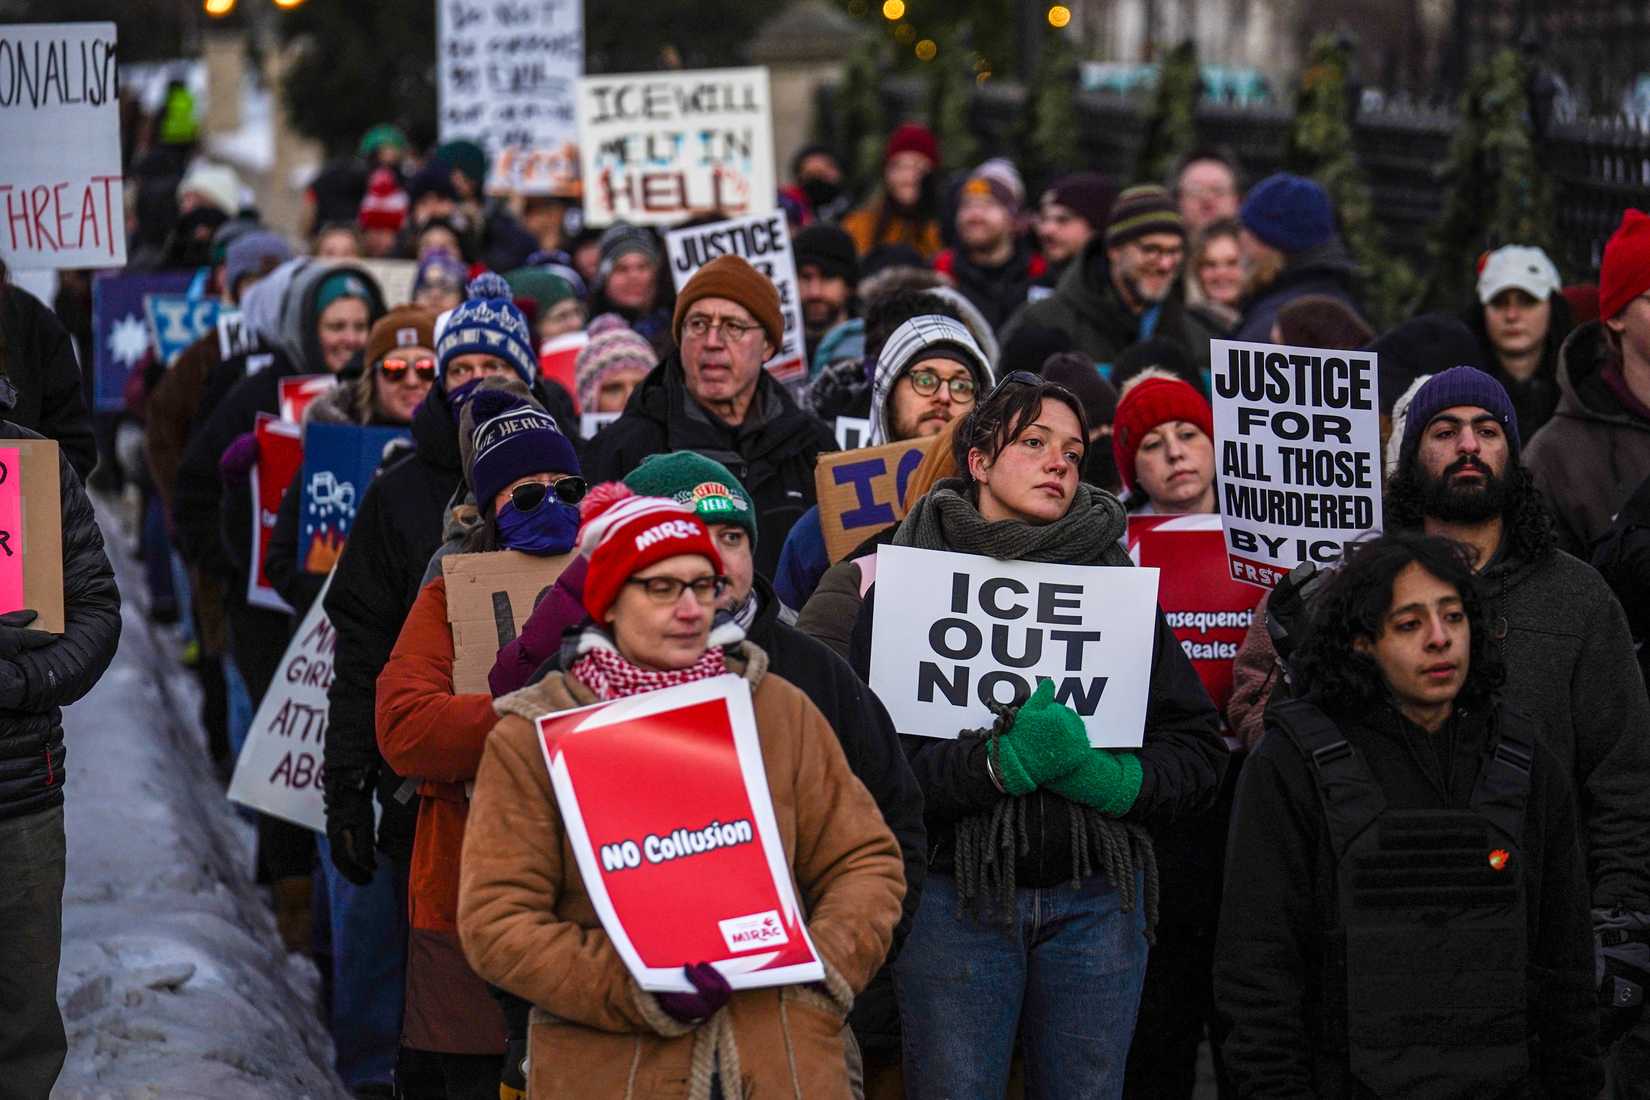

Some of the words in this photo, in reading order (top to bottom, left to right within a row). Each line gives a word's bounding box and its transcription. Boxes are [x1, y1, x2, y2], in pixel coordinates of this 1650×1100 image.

[590, 82, 673, 125] ICE
[674, 82, 759, 115] WILL
[597, 131, 684, 167] MELT
[698, 128, 752, 168] IN
[599, 167, 749, 213] HELL
[676, 218, 784, 272] JUSTICE
[1215, 349, 1372, 411] JUSTICE
[1238, 407, 1352, 444] FOR
[1222, 440, 1272, 482] ALL
[1278, 446, 1372, 489] THOSE
[1225, 483, 1373, 529] MURDERED
[1230, 527, 1288, 559] BY
[950, 572, 1084, 626] ICE
[928, 617, 1101, 672] OUT
[1181, 640, 1237, 660] Reales
[917, 660, 1109, 717] NOW
[601, 840, 641, 872] NO
[644, 819, 753, 864] Collusion
[733, 926, 781, 944] MIRAC
